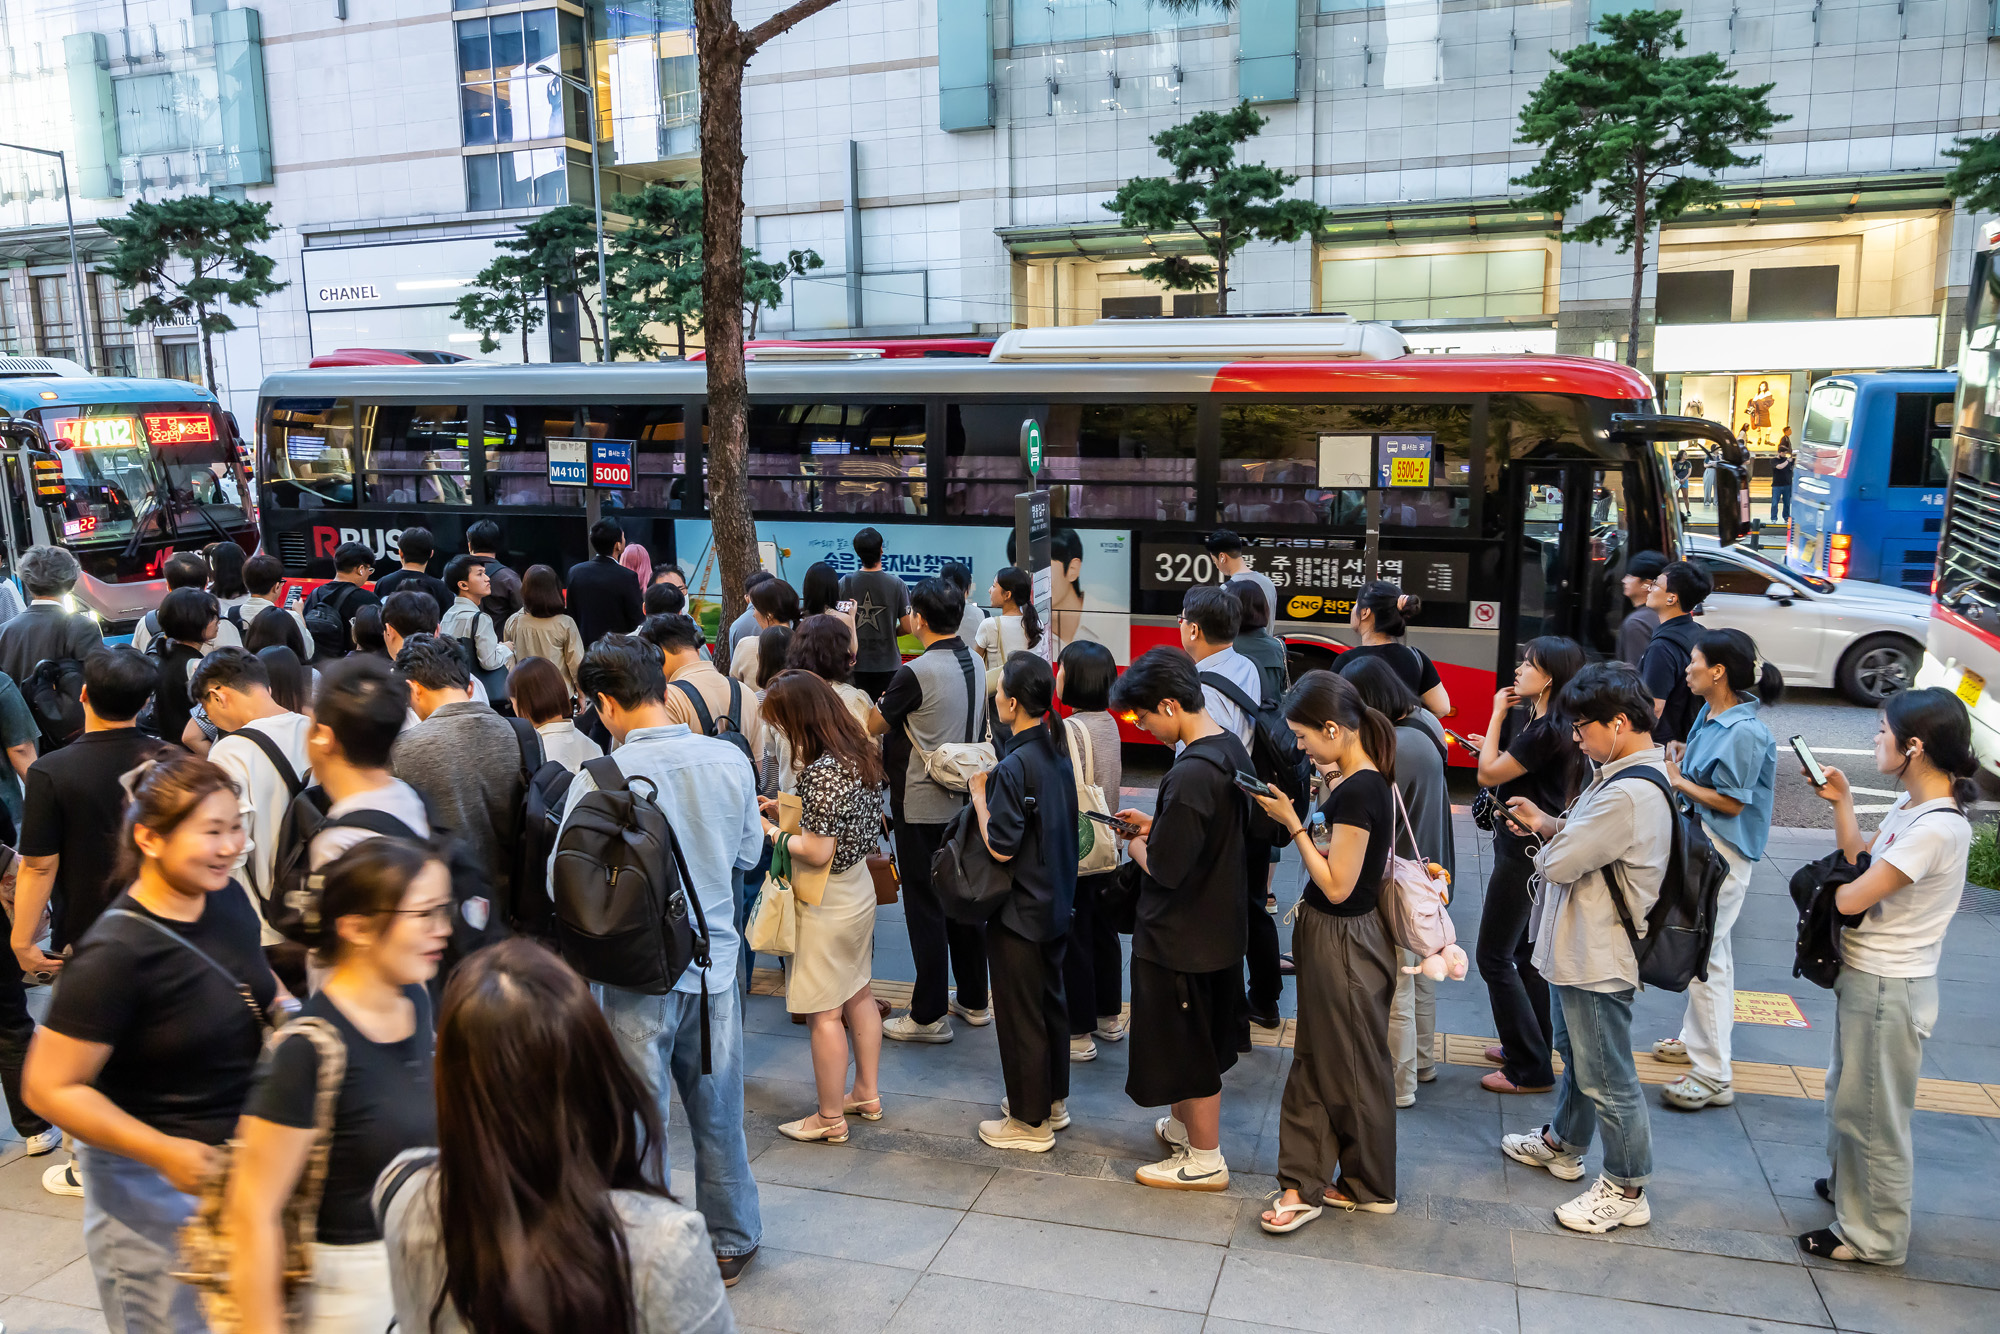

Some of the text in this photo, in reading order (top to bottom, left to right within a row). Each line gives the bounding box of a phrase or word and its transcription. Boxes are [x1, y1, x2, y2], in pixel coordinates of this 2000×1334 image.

[319, 286, 379, 301] CHANEL
[154, 316, 197, 327] AVENUEL
[62, 420, 132, 446] M4102
[1401, 443, 1425, 451] 줄서는 곳
[551, 466, 585, 478] M4101
[595, 467, 628, 482] 5000
[1397, 461, 1424, 478] 5500-2
[1921, 494, 1944, 505] 서울
[80, 516, 96, 531] 22
[824, 552, 855, 571] 숨은
[857, 553, 921, 573] 융자산
[1343, 558, 1403, 574] 서역
[1291, 600, 1320, 609] CNG
[1528, 1144, 1539, 1154] N
[1601, 1204, 1617, 1217] N
